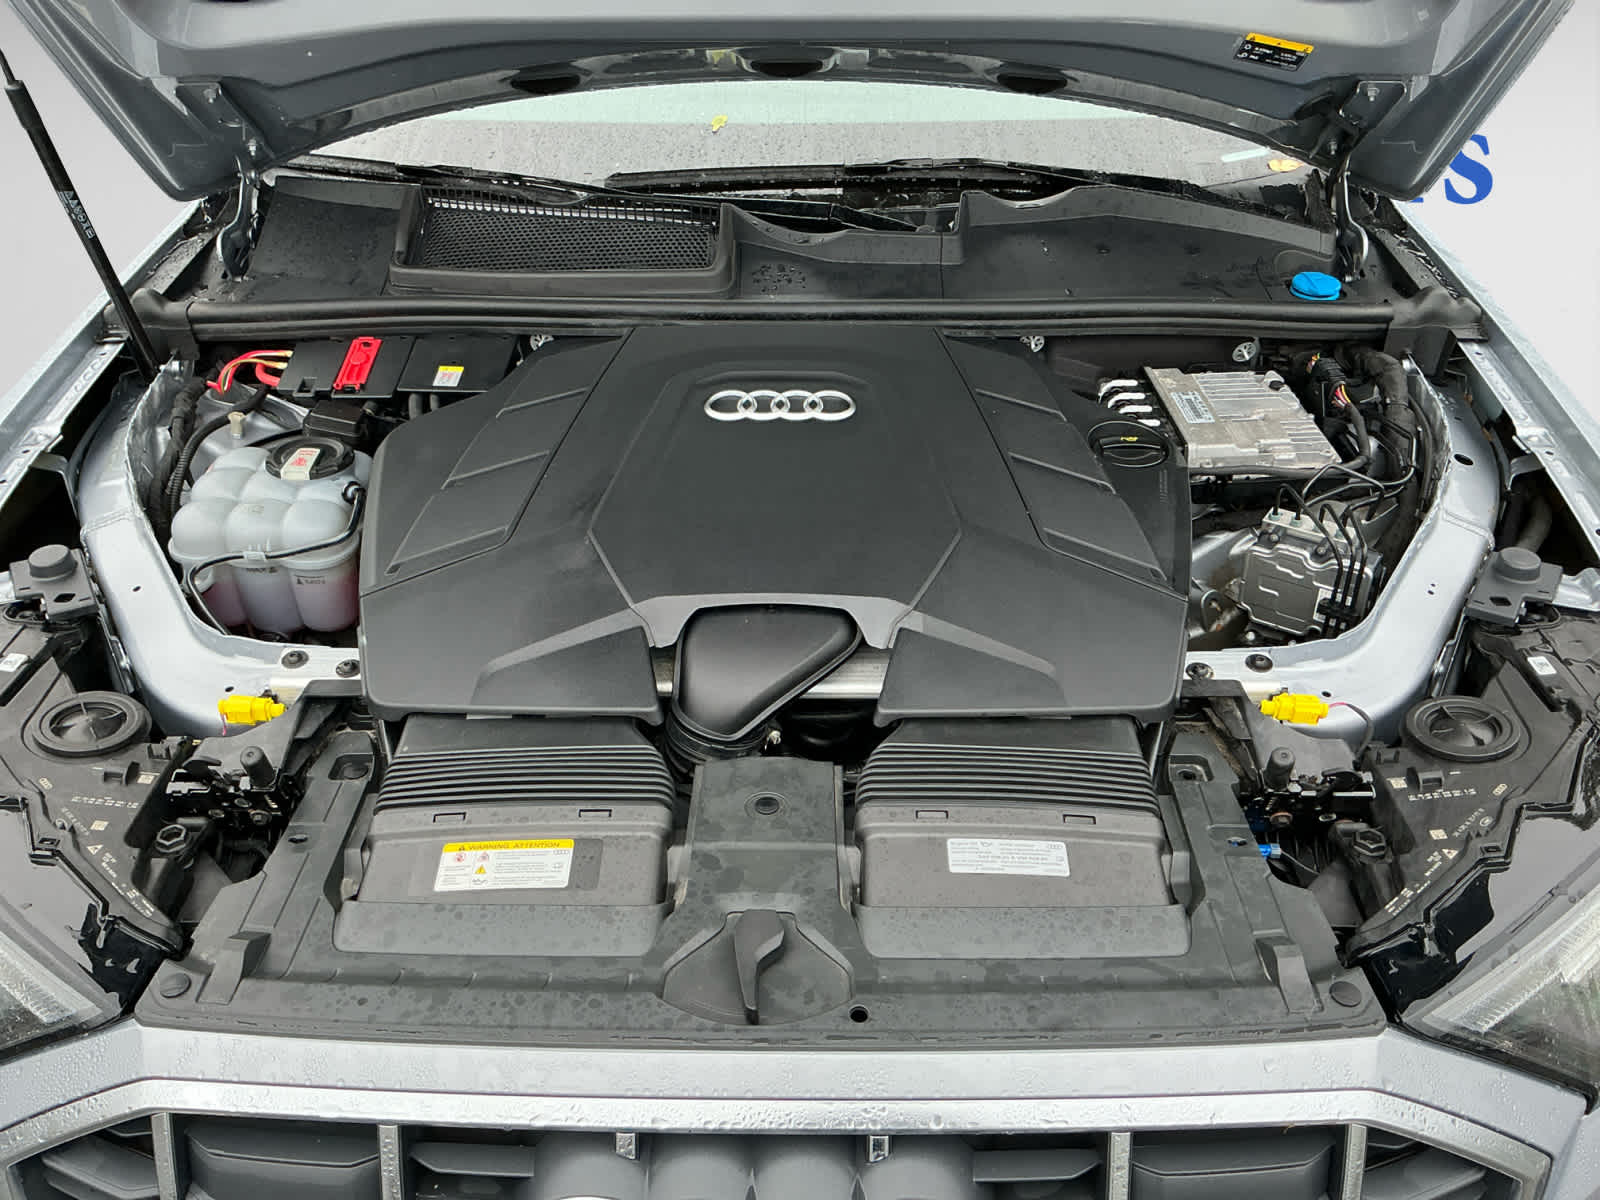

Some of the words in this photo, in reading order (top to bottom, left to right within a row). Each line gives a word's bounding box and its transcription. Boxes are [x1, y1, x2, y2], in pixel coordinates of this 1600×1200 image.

[1409, 133, 1493, 205] S
[468, 843, 510, 851] WARNING
[513, 841, 560, 849] ATTENTION
